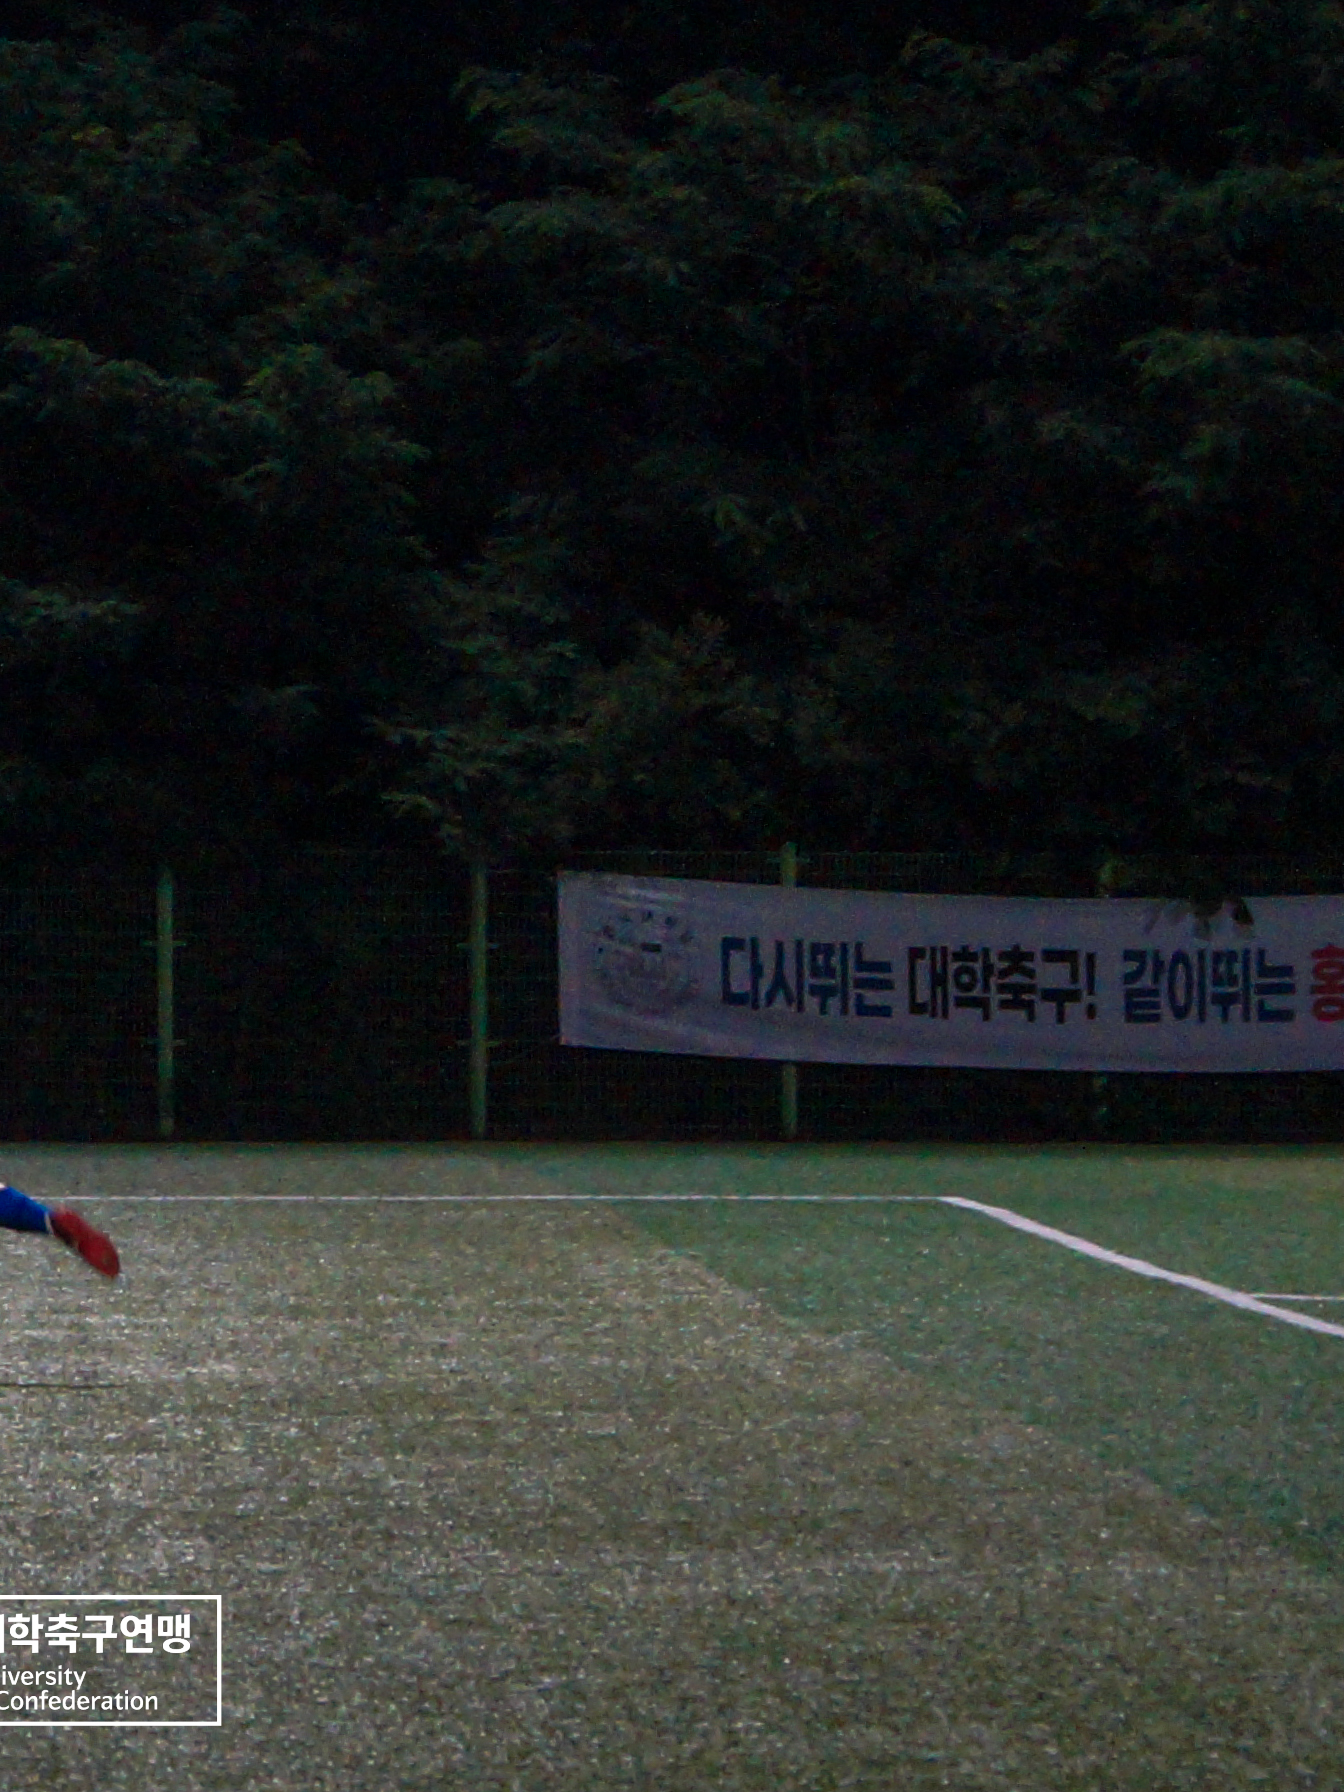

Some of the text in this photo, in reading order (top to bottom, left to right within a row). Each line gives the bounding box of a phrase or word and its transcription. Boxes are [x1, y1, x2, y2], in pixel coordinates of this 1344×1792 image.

[721, 936, 894, 1018] 다시뛰는
[908, 944, 1097, 1023] 대학축구!
[1122, 947, 1297, 1023] 같이뛰는
[1309, 943, 1344, 1022] 홍
